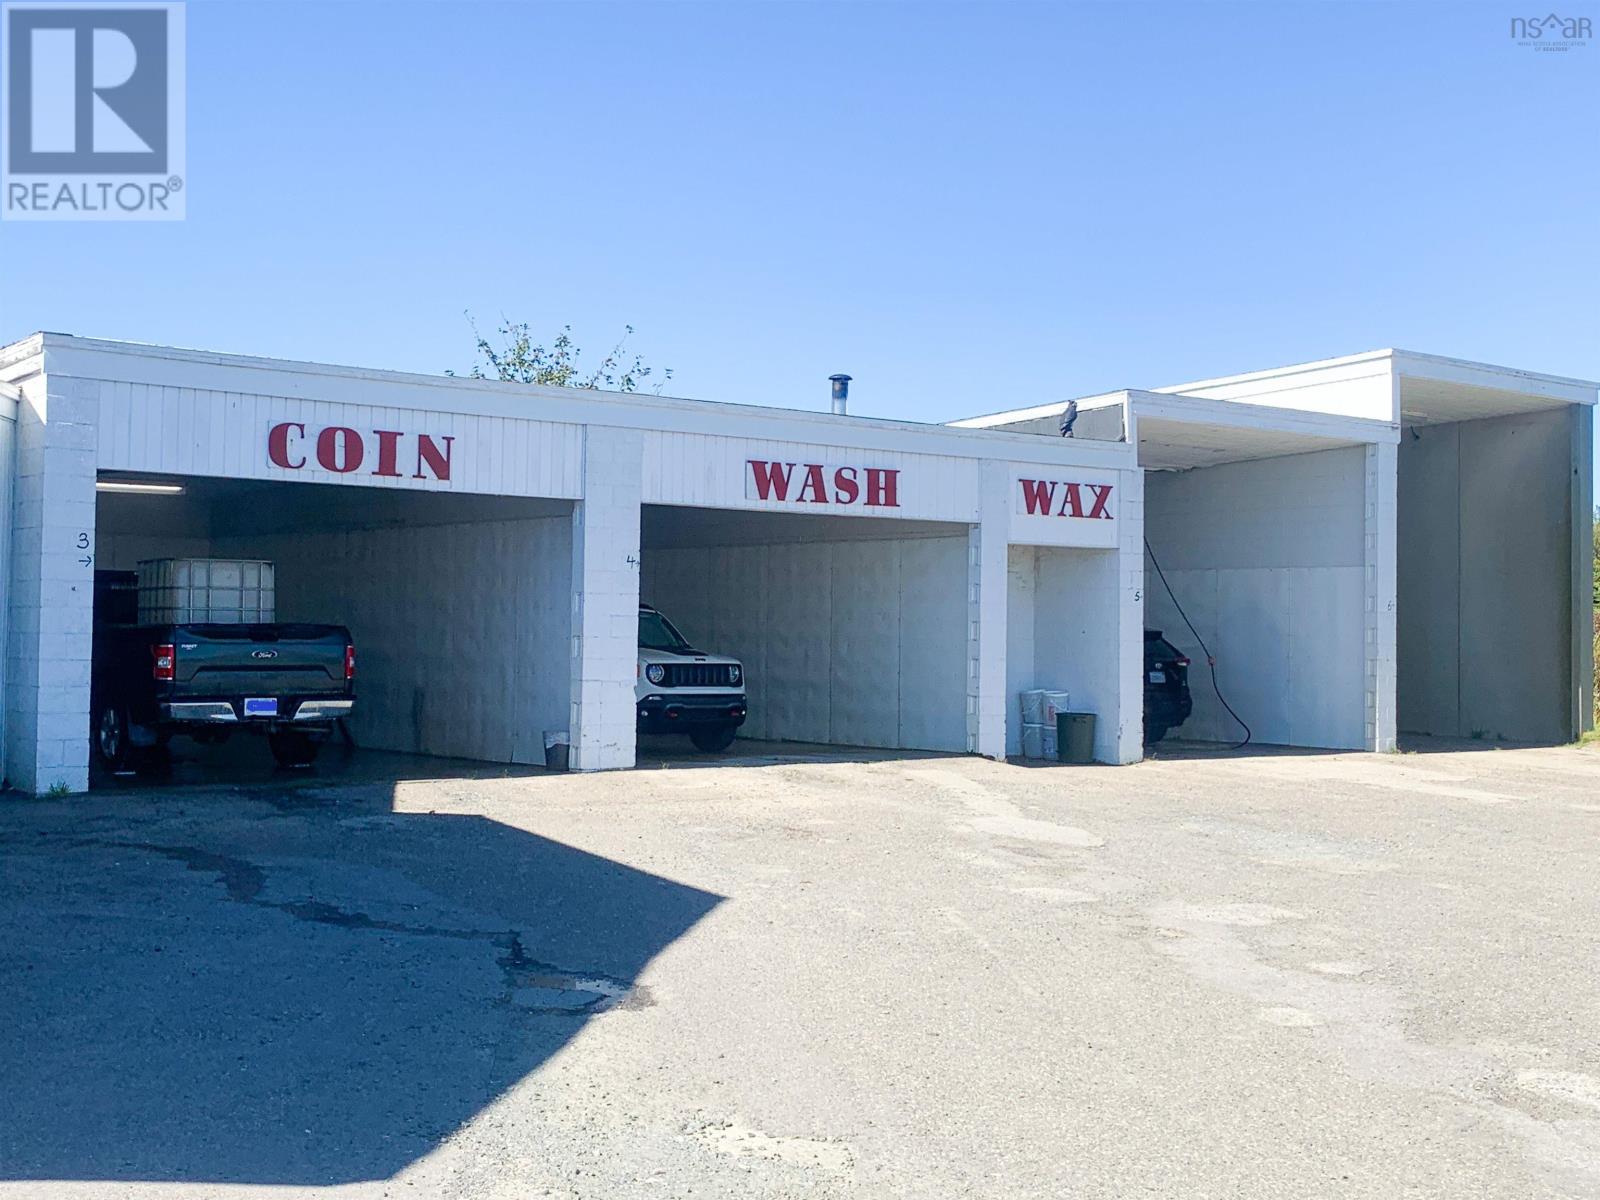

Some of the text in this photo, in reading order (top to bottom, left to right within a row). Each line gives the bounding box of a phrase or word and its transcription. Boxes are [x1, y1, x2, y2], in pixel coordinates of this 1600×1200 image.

[268, 422, 455, 480] COIN
[747, 460, 900, 507] WASH
[1018, 478, 1114, 520] WAX
[76, 532, 90, 549] 3
[626, 555, 636, 569] 4
[1134, 591, 1140, 602] 5
